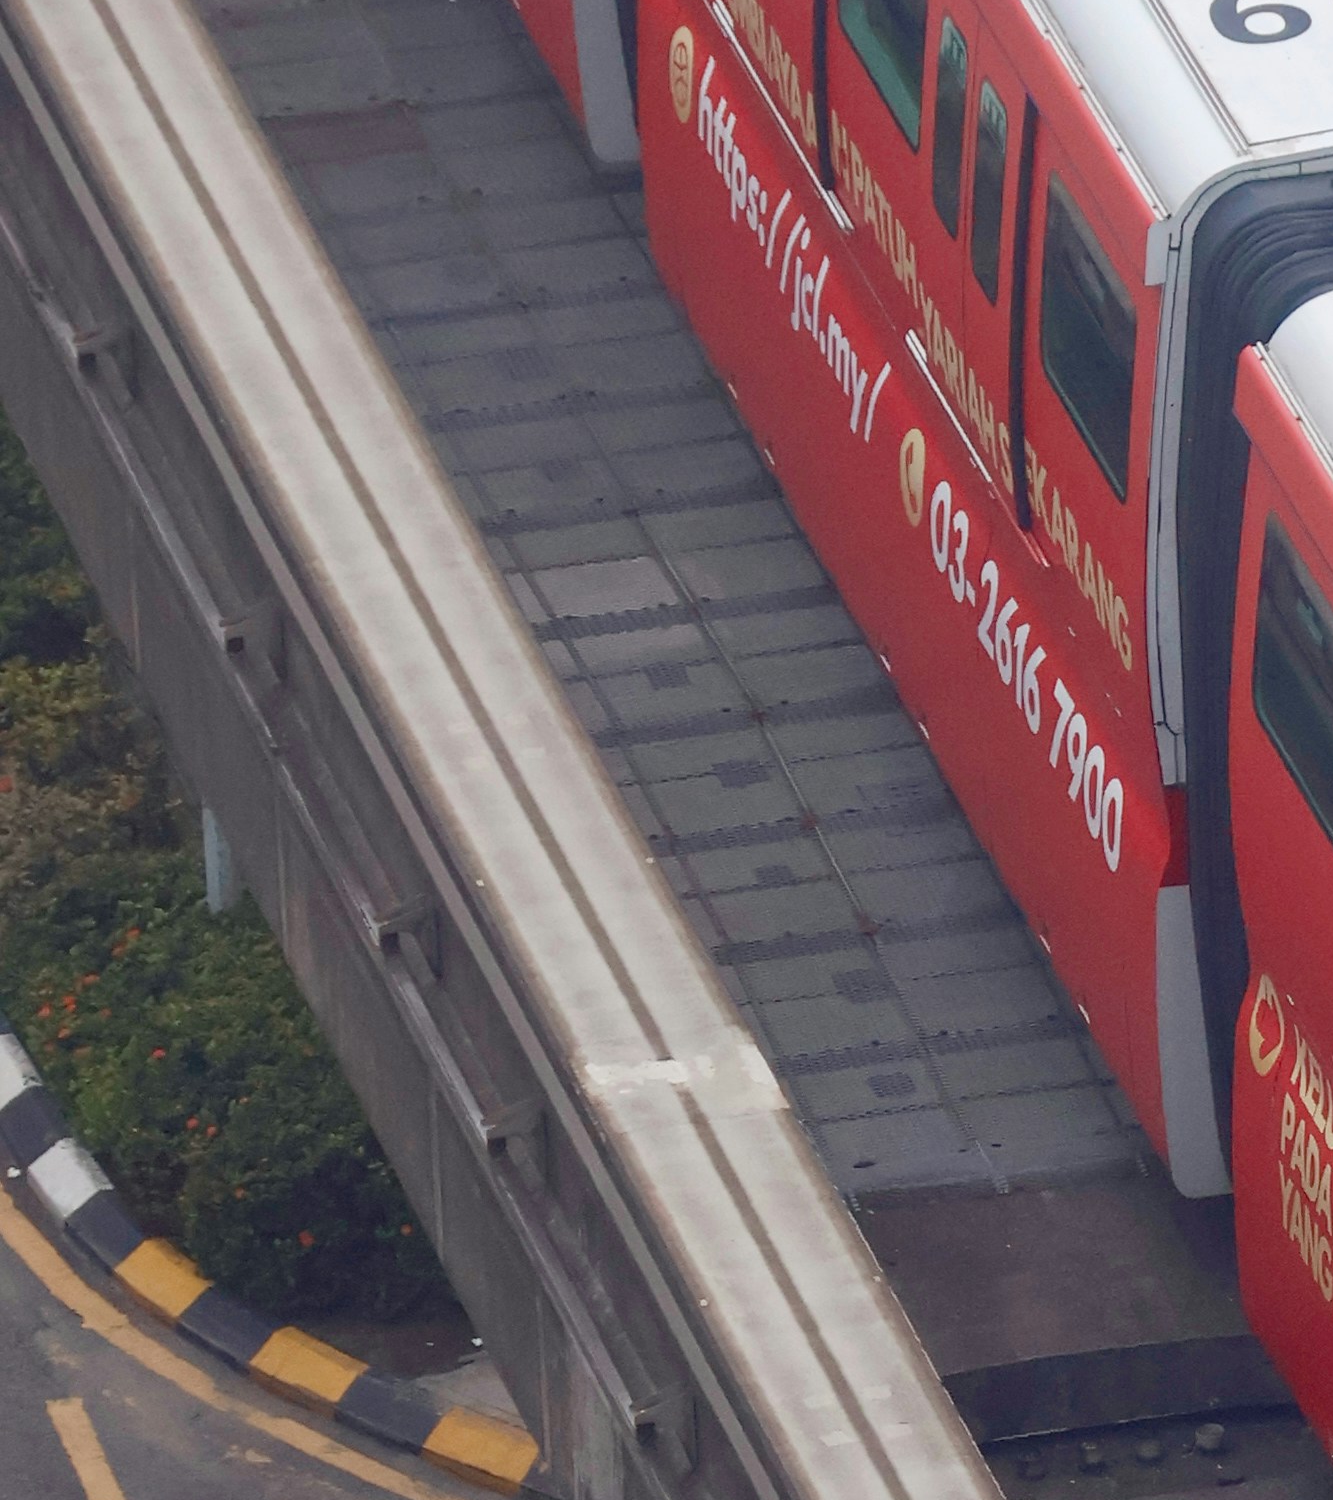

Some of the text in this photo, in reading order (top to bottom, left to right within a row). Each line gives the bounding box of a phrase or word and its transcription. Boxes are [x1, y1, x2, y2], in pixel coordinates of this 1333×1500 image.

[698, 55, 892, 443] https://jcl.my/
[850, 140, 918, 310] PATUH
[930, 479, 1123, 872] 03-2616 7900
[1278, 1160, 1333, 1302] YANG
[1279, 1092, 1333, 1236] PADA
